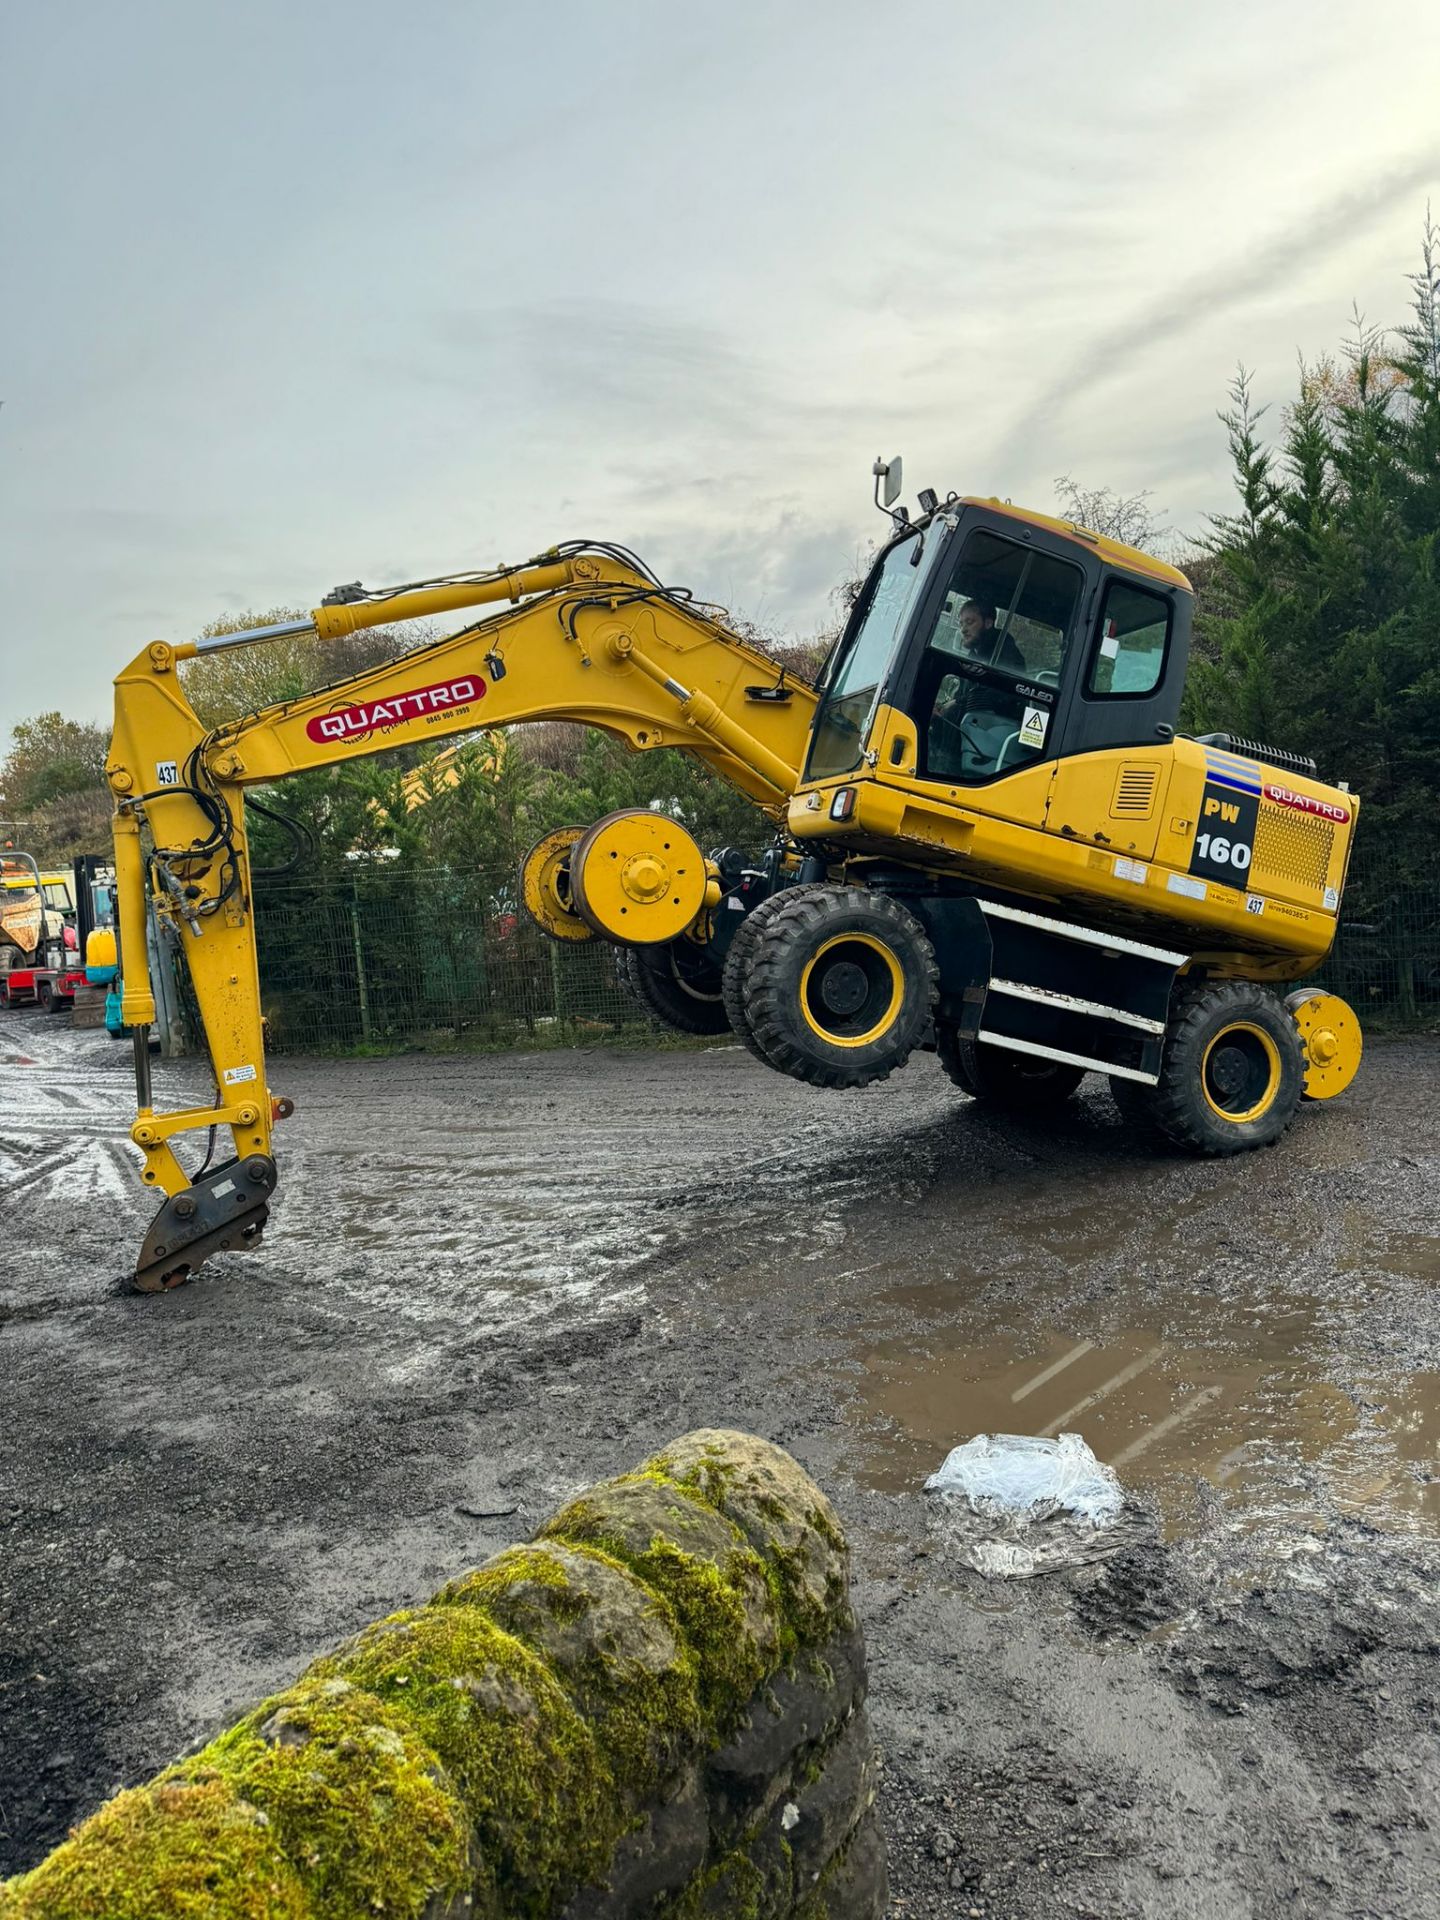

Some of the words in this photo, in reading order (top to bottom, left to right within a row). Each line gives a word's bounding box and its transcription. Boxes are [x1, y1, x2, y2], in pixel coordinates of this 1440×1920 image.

[320, 681, 475, 737] QUATTRO
[425, 714, 442, 725] 0845
[380, 717, 410, 735] Group
[159, 766, 177, 783] 437
[1204, 797, 1240, 824] PW
[1270, 787, 1344, 819] QUATTRO
[1196, 833, 1251, 869] 160
[1248, 899, 1262, 913] 437
